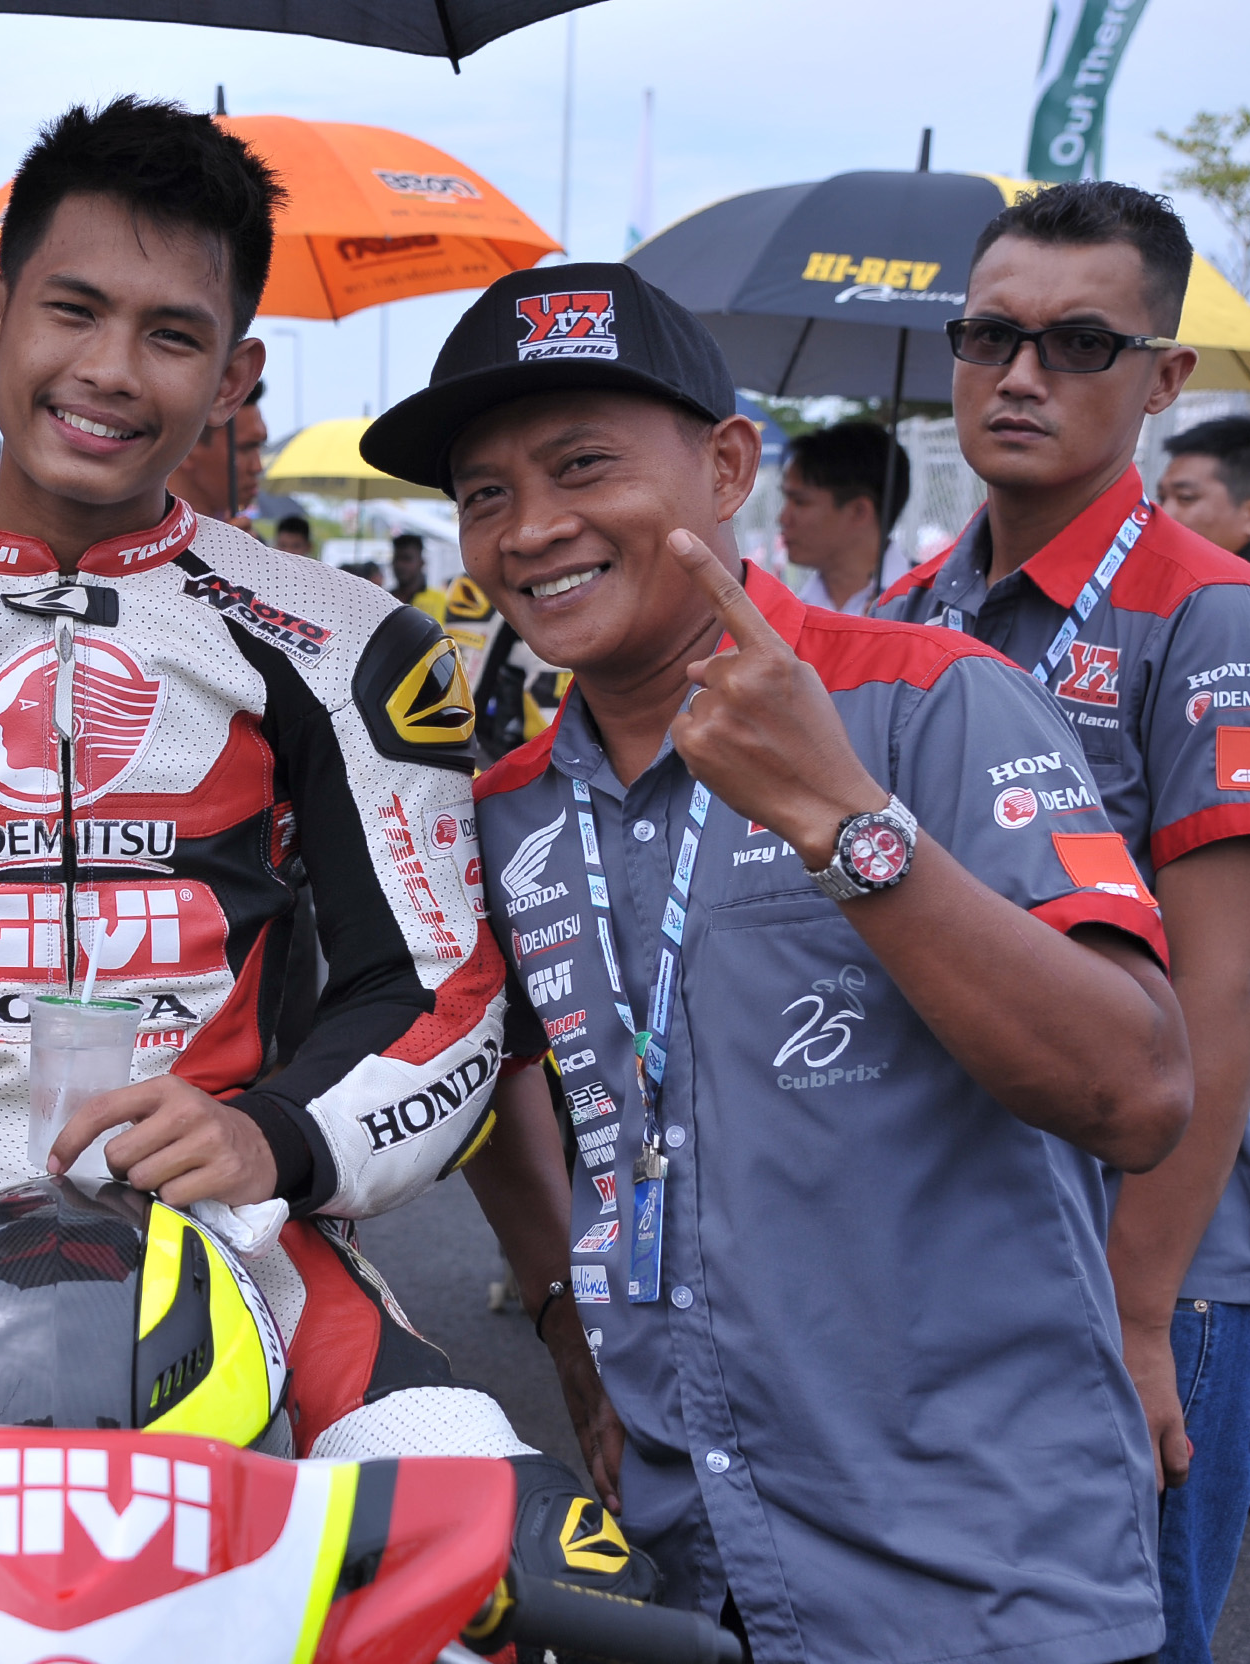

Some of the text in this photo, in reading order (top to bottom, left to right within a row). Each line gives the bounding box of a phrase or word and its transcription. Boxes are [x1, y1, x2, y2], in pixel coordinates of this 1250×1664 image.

[1048, 94, 1097, 167] Out
[802, 252, 941, 291] HI-REV
[1187, 662, 1250, 690] HON
[1078, 711, 1119, 730] Racin
[987, 752, 1086, 786] HON
[733, 843, 776, 867] Yuzy
[505, 881, 570, 918] HONDA
[520, 913, 581, 956] IDEMITSU
[527, 962, 573, 1009] GIVI
[772, 995, 865, 1069] 25
[559, 1048, 597, 1076] RCB
[777, 1064, 882, 1090] CubPrix
[361, 1038, 500, 1151] HONDA
